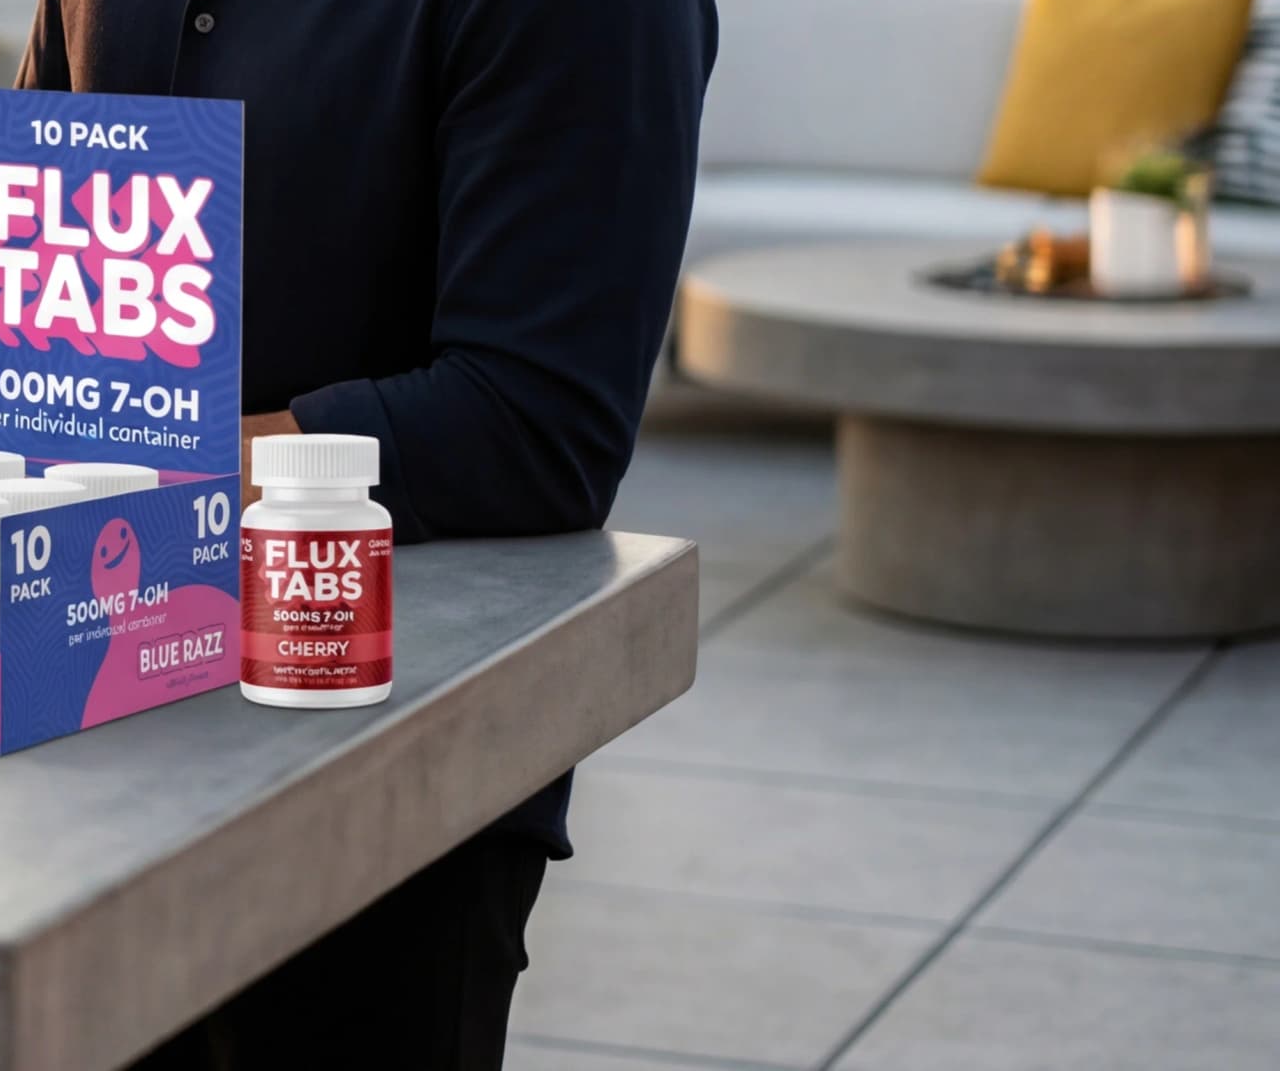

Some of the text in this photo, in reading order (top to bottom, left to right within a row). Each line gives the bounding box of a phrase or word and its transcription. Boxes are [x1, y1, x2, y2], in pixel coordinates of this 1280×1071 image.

[31, 120, 149, 151] 10 PACK
[110, 382, 200, 422] 7-OH
[15, 409, 104, 440] individual
[193, 491, 230, 539] 10
[11, 525, 51, 575] 10
[193, 541, 229, 565] PACK
[265, 539, 362, 569] FLUX
[11, 577, 51, 603] PACK
[265, 570, 363, 601] TABS
[66, 591, 125, 626] 500MG
[129, 581, 168, 611] 7-OH
[141, 631, 223, 673] BLUE RAZZ
[278, 640, 350, 656] CHERRY
